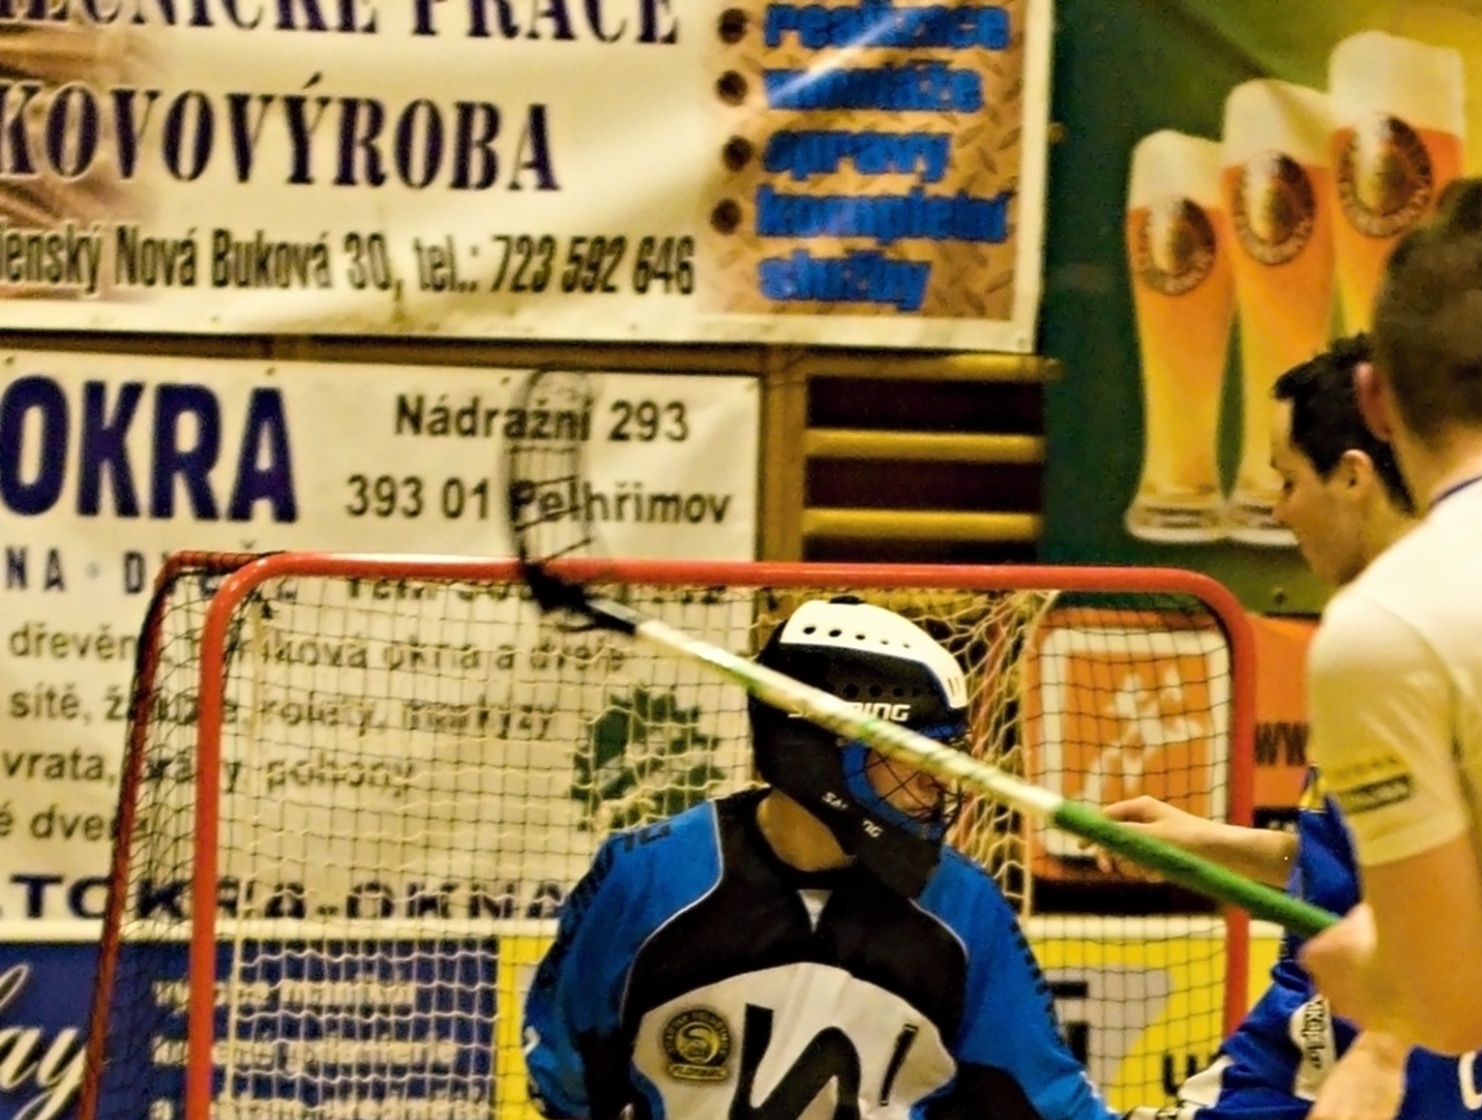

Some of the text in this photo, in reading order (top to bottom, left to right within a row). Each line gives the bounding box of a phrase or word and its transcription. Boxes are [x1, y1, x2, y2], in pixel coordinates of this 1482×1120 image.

[114, 225, 197, 289] Nová
[211, 228, 331, 290] Buková
[345, 232, 404, 297] 30,
[491, 234, 556, 294] 723
[562, 235, 625, 295] 592
[632, 236, 696, 296] 646
[395, 394, 689, 443] Nádražní 293
[0, 374, 297, 522] OKRA
[345, 474, 731, 525] 393 01 Pelhřimov
[10, 681, 92, 726] sítě,
[2, 746, 117, 789] vrata,
